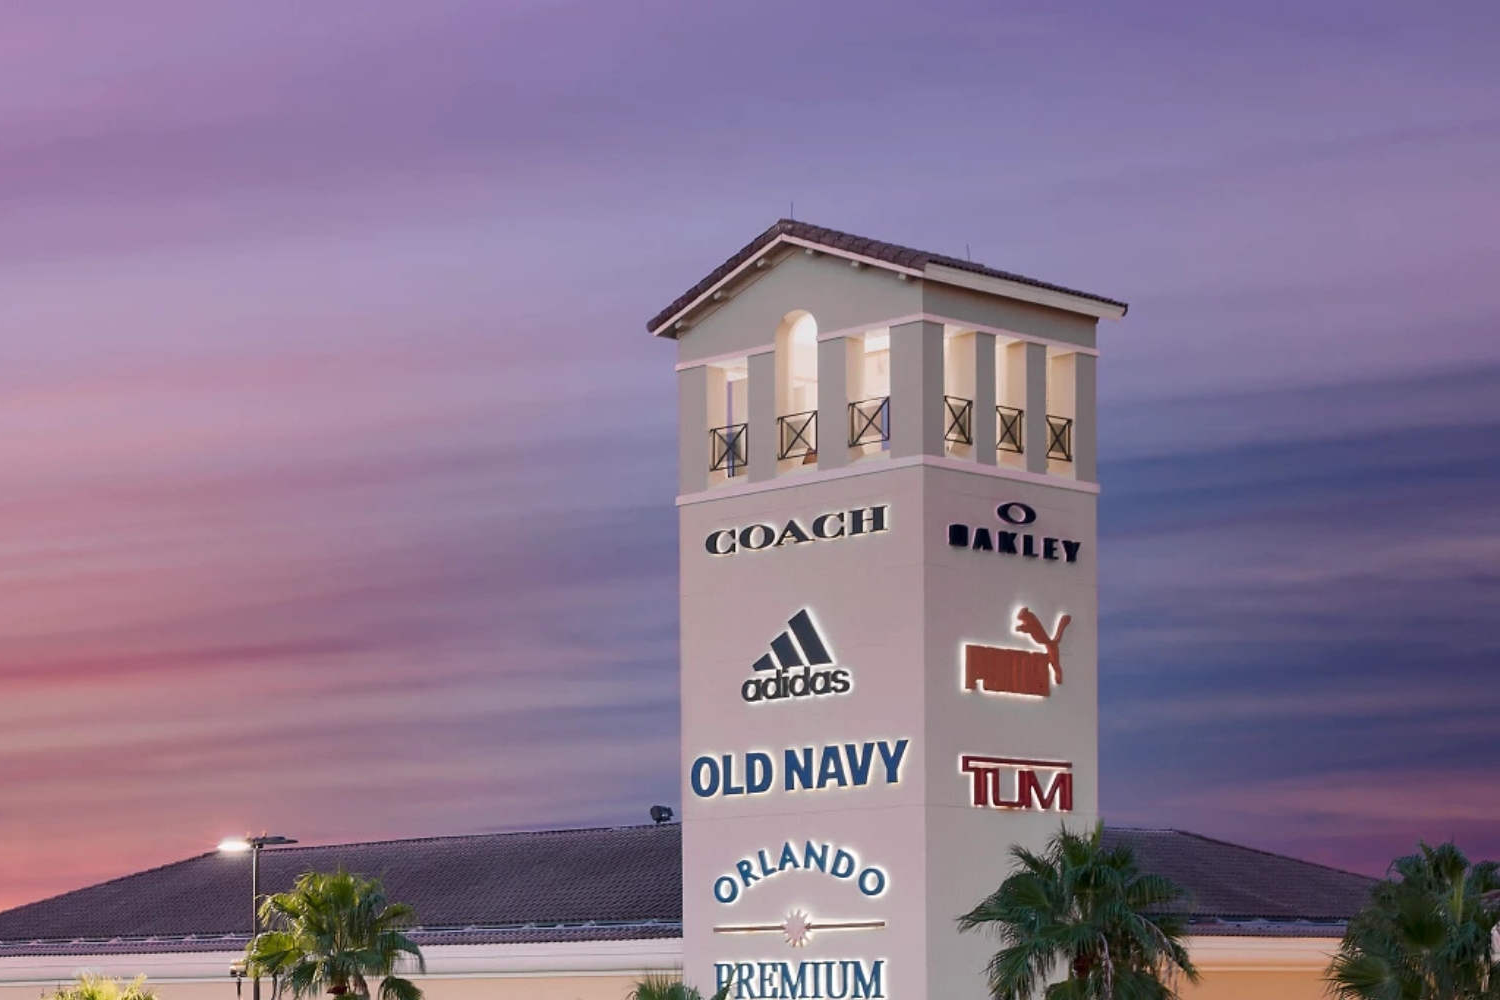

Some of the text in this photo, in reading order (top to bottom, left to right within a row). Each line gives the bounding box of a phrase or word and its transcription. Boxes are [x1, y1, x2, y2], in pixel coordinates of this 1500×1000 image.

[705, 505, 889, 556] COACH
[741, 667, 851, 703] adidas
[691, 739, 909, 798] OLD NAVY
[713, 841, 886, 903] ORLANDO
[713, 960, 885, 1000] PREMIUM
